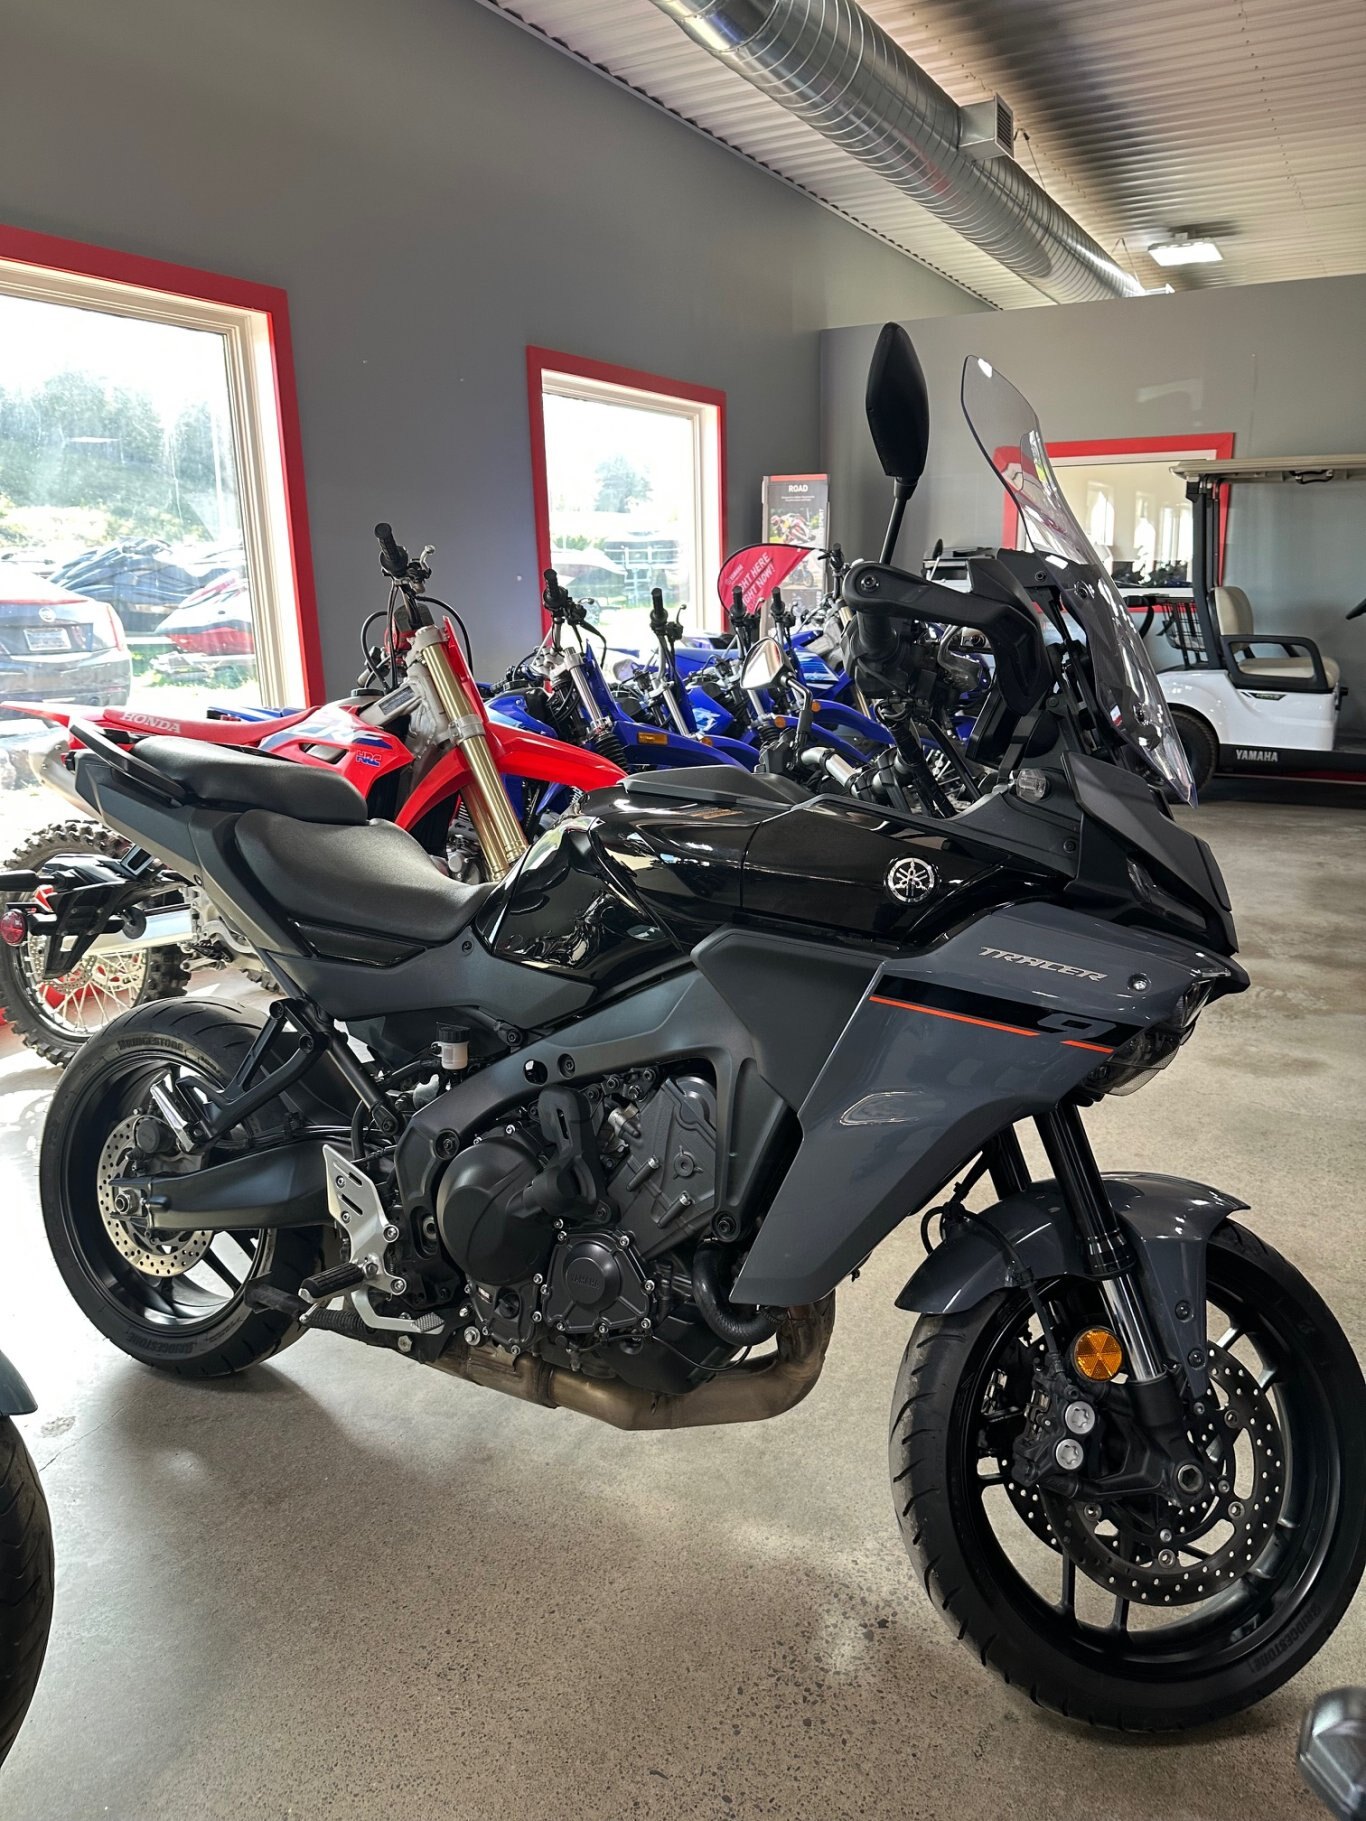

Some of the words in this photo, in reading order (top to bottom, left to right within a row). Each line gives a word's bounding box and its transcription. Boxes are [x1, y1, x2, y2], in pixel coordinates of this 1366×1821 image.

[788, 484, 808, 492] ROAD
[750, 552, 770, 575] HERE
[742, 587, 758, 605] IGHT
[755, 562, 776, 588] NOW!
[120, 711, 181, 734] HONDA
[355, 749, 382, 767] HRC
[1235, 749, 1278, 762] YAMAHA
[978, 946, 1108, 982] TRACER
